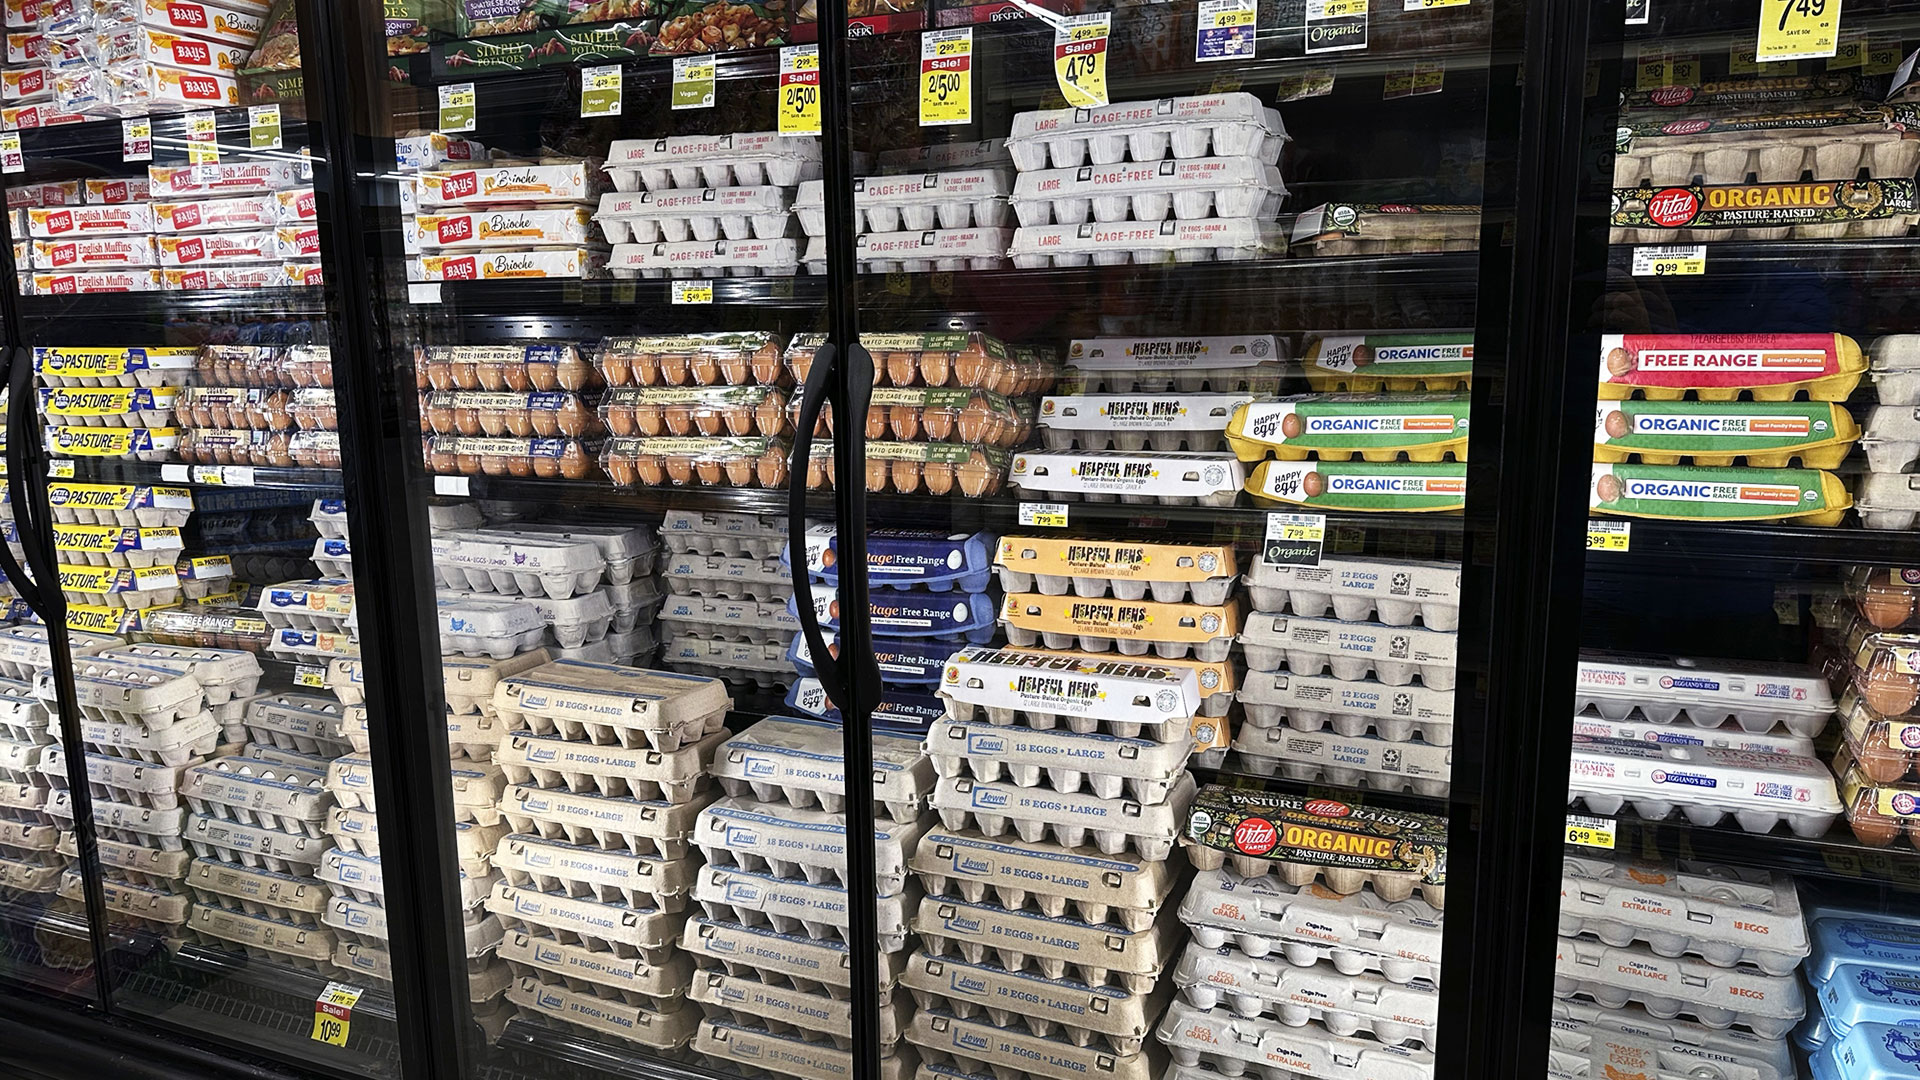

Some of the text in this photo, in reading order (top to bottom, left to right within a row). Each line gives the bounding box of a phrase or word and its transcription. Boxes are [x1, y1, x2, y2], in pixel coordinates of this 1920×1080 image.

[171, 8, 202, 23] BAYS
[571, 30, 620, 45] SIMPLY
[1311, 23, 1362, 42] Organic
[176, 45, 206, 61] BAYS
[572, 43, 621, 55] POTATOES
[1065, 41, 1096, 54] Sale!
[932, 59, 961, 69] Sale!
[789, 73, 816, 83] Sale!
[184, 81, 215, 95] BAYS
[1093, 109, 1153, 125] CAGE-FREE
[1035, 118, 1058, 131] LARGE
[627, 148, 645, 160] LARGE
[671, 142, 719, 155] CAGE-FREE
[573, 174, 580, 186] 6
[1094, 169, 1154, 185] CAGE-FREE
[869, 183, 922, 196] CAGE-FREE
[1038, 178, 1061, 191] LARGE
[657, 195, 702, 207] CAGE-FREE
[1709, 186, 1830, 207] ORGANIC
[1651, 194, 1692, 218] Vital
[1884, 199, 1911, 208] LARGE
[75, 209, 131, 222] English Muffins
[175, 211, 197, 223] BAYS
[1662, 213, 1688, 222] FARMS
[1723, 209, 1815, 220] PASTURE-RAISED
[49, 217, 70, 228] BAYS
[441, 220, 468, 237] BAYS
[491, 215, 531, 231] Brioche
[54, 249, 75, 261] BAYS
[79, 243, 132, 255] English Muffins
[180, 244, 201, 258] BAYS
[446, 261, 472, 278] BAYS
[495, 256, 534, 273] Brioche
[568, 261, 574, 272] 6
[804, 337, 826, 346] LARGE
[1379, 348, 1440, 360] ORGANIC
[1644, 354, 1758, 367] FREE RANGE
[64, 353, 107, 369] PASTURE
[1783, 357, 1802, 365] Family
[616, 391, 637, 401] LARGE
[1107, 401, 1180, 416] HELPFUL HENS
[1254, 412, 1281, 427] HAPPY
[1311, 419, 1379, 431] ORGANIC
[1380, 418, 1401, 426] FREE
[1640, 418, 1720, 432] ORGANIC
[1253, 422, 1277, 437] egg
[72, 434, 115, 448] PASTURE
[1079, 461, 1152, 477] HELPFUL HENS
[1275, 470, 1301, 484] HAPPY
[1274, 479, 1299, 495] egg
[1332, 479, 1401, 491] ORGANIC
[68, 491, 117, 506] PASTURE
[58, 531, 105, 549] PASTURE
[1067, 545, 1144, 563] HELPFUL HENS
[1268, 545, 1316, 559] Organic
[896, 555, 945, 566] Free Range
[1341, 571, 1350, 579] 12
[1353, 572, 1378, 580] EGGS
[1342, 580, 1375, 590] LARGE
[903, 608, 950, 618] Free Range
[1339, 633, 1376, 643] 12 EGGS
[1340, 643, 1373, 652] LARGE
[1581, 672, 1626, 681] VITAMINS
[1018, 675, 1098, 699] HELPFUL HENS
[1674, 680, 1718, 690] EGGLAND'S BEST
[1756, 684, 1766, 695] 12
[527, 694, 547, 704] Jewel
[803, 688, 823, 697] HAPPY
[1353, 692, 1379, 700] EGGS
[803, 695, 821, 707] egg
[1343, 700, 1376, 709] LARGE
[566, 702, 587, 711] EGGS
[594, 705, 622, 715] LARGE
[976, 738, 1003, 750] Jewel
[1016, 743, 1105, 760] 18 EGGS LARGE
[1667, 775, 1715, 786] EGGLAND'S BEST
[1780, 789, 1792, 797] FREE
[1231, 795, 1303, 809] PASTURE
[1351, 810, 1422, 830] RAISED
[734, 832, 757, 842] Jewel
[1236, 825, 1271, 844] Vital
[779, 840, 803, 849] EGGS
[812, 844, 843, 854] LARGE
[1287, 826, 1391, 857] ORGANIC
[1296, 849, 1374, 865] PASTURE-RAISED
[964, 856, 989, 872] Jewel
[1000, 866, 1089, 889] 18 EGGS LARGE
[1220, 902, 1239, 912] EGGS
[1633, 895, 1662, 907] Cage Free
[1212, 907, 1246, 921] GRADE A
[1622, 901, 1672, 917] EXTRA LARGE
[1734, 920, 1769, 935] 18 EGGS
[1295, 927, 1342, 943] EXTRA LARGE
[1878, 951, 1904, 959] EGGS
[322, 1004, 344, 1016] Sale!
[1672, 1046, 1738, 1064] CAGE FREE
